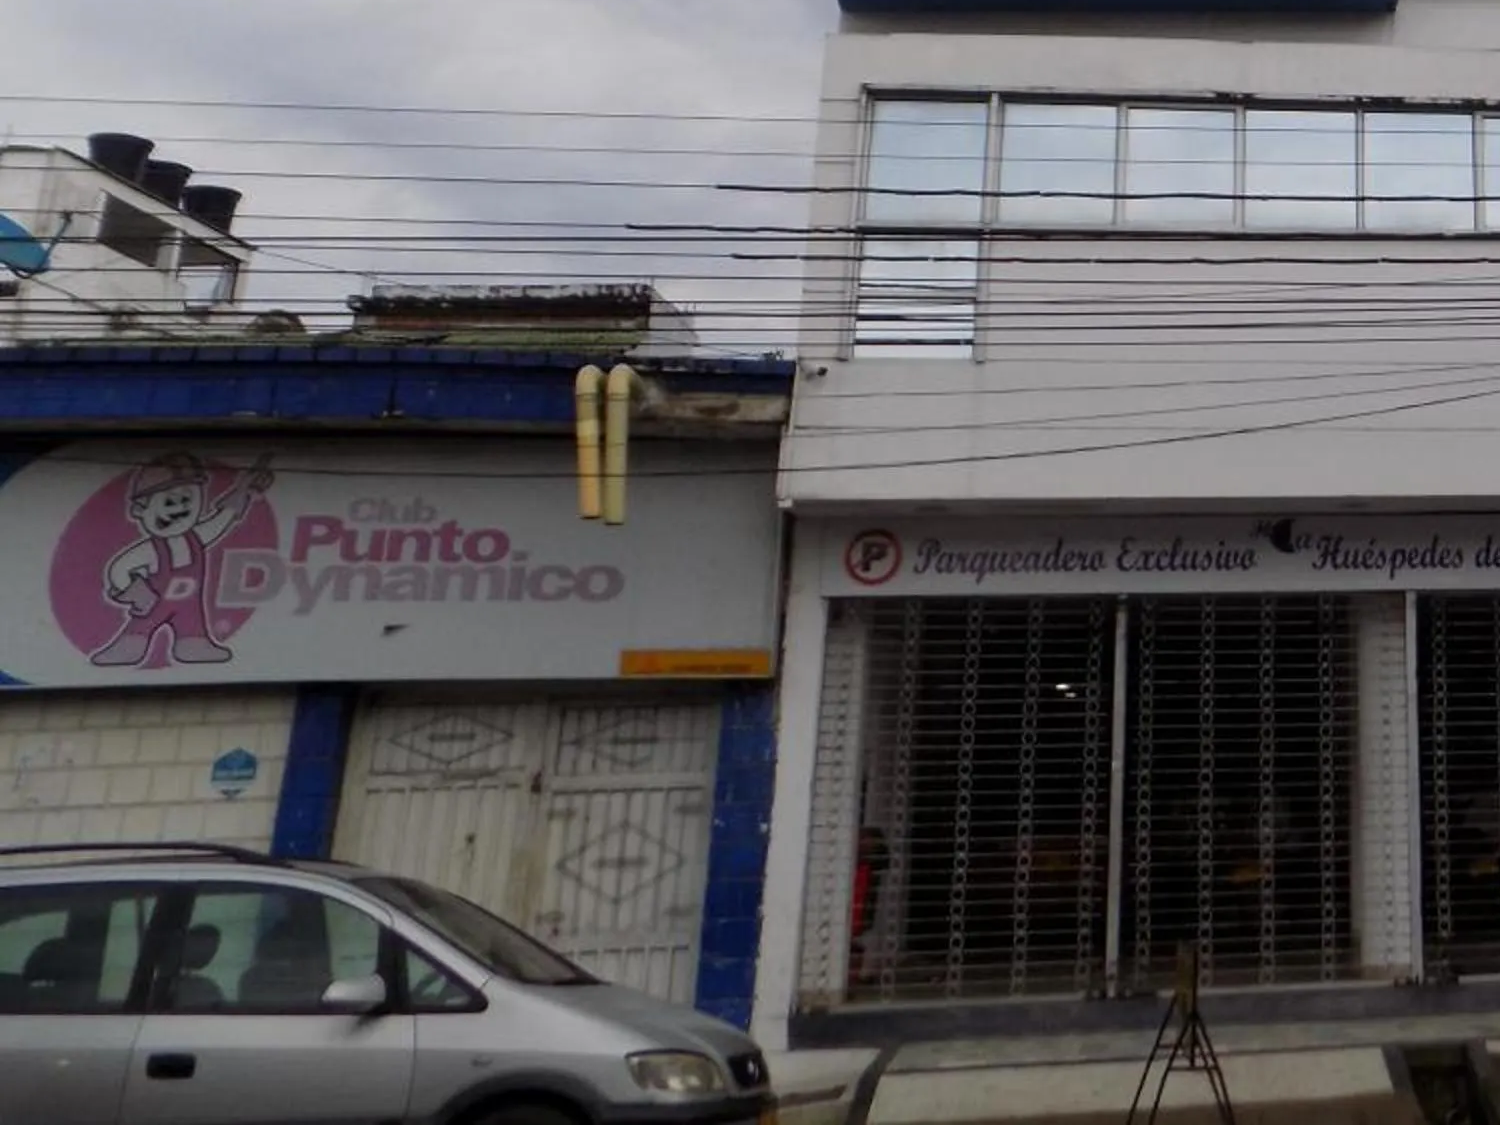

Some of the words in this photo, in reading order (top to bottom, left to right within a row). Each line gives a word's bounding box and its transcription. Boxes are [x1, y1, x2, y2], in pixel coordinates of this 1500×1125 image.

[348, 496, 436, 523] Club
[289, 515, 510, 563] Punto
[912, 537, 1104, 585] Parqueadero
[1115, 536, 1258, 572] Exclusivo
[1311, 534, 1465, 579] Huéspedes
[215, 548, 626, 616] Dynamico
